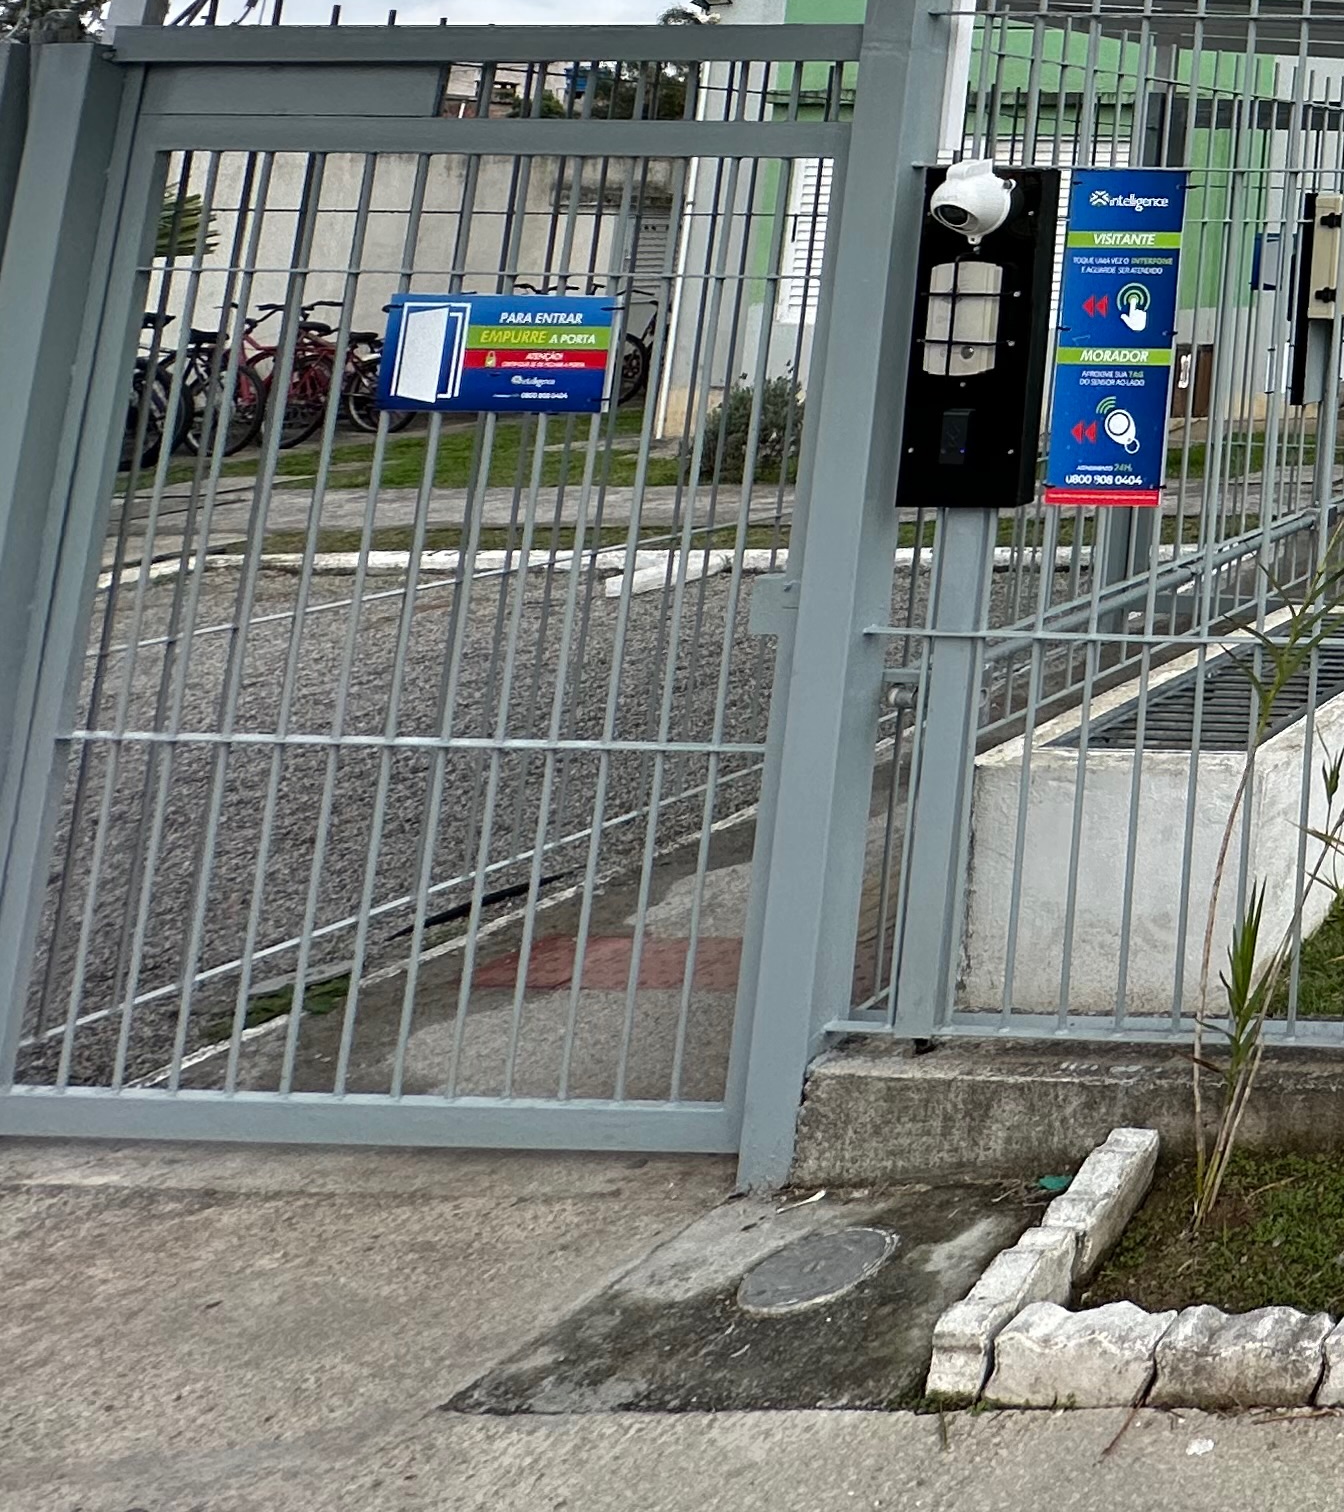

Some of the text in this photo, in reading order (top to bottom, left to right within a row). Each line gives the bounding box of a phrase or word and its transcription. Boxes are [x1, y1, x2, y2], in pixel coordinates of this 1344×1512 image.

[1093, 233, 1156, 245] VISITANTE
[499, 312, 584, 324] PARA ENTRAR
[480, 330, 596, 344] EMPURRE A PORTA
[1080, 350, 1149, 362] MORADOR
[1065, 474, 1092, 485] 0800
[1114, 475, 1142, 486] 0404
